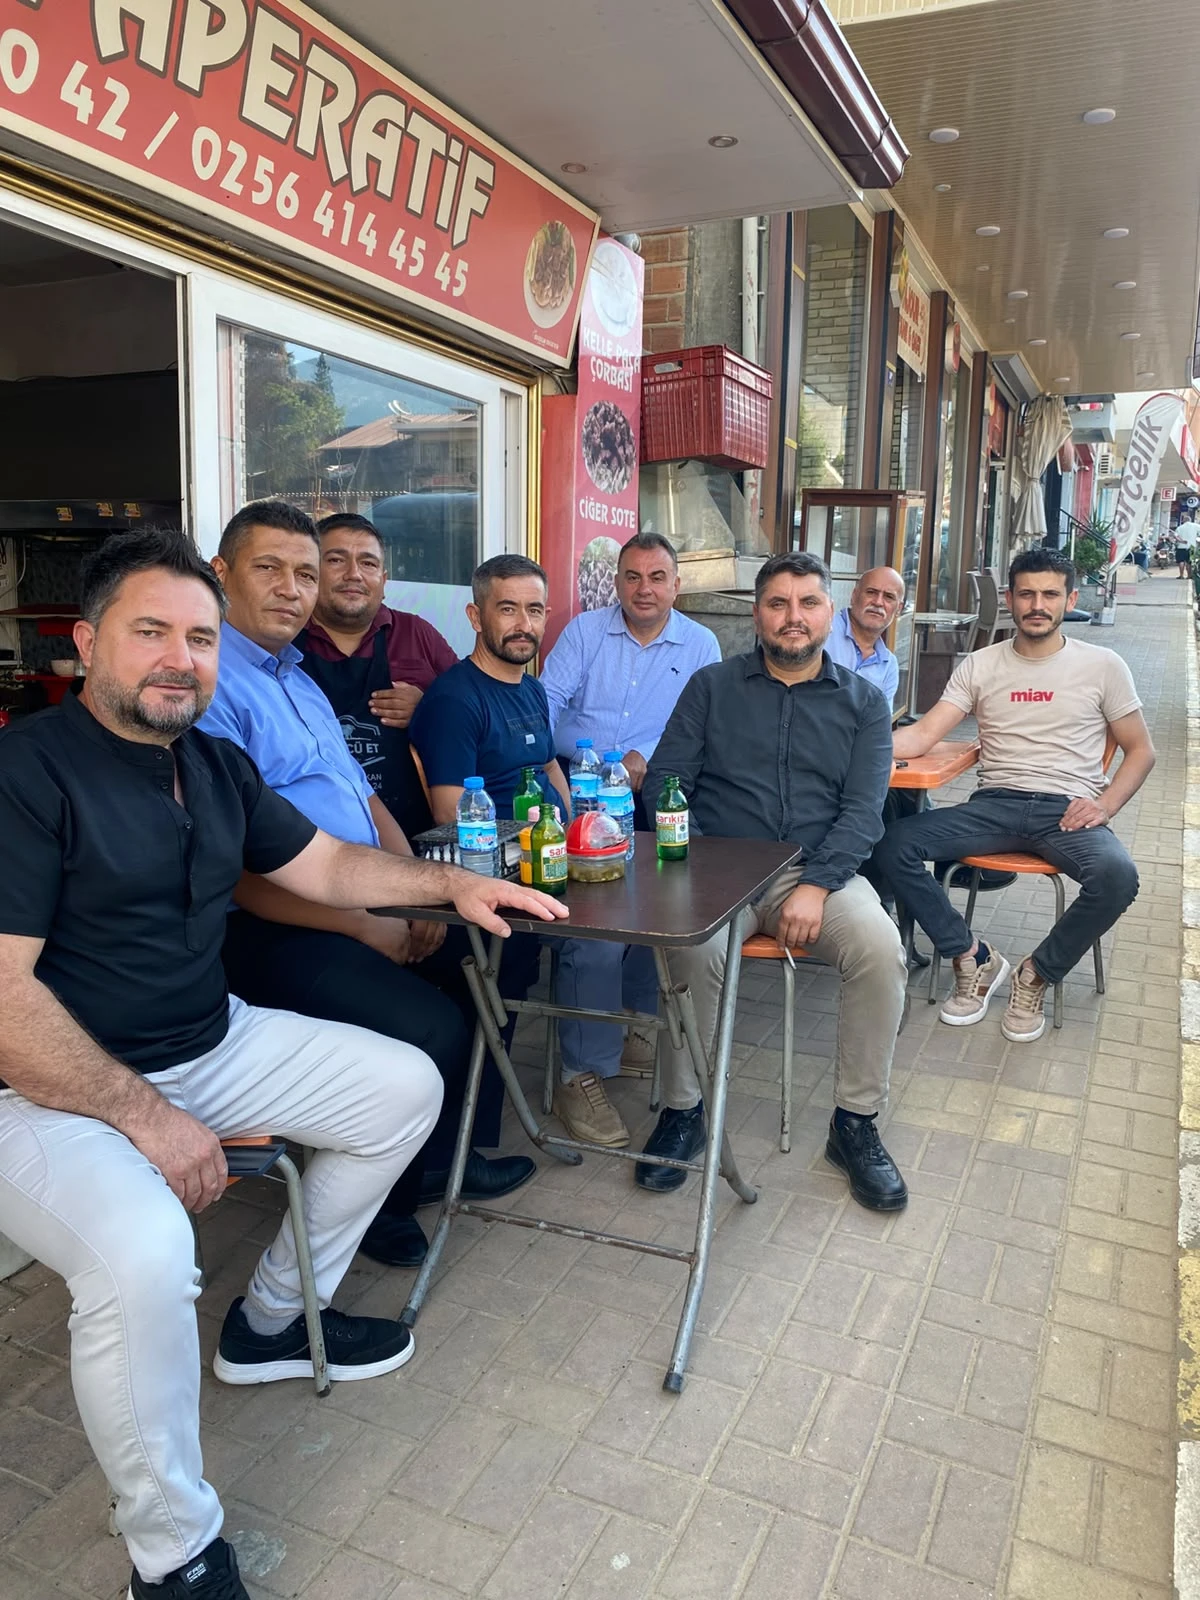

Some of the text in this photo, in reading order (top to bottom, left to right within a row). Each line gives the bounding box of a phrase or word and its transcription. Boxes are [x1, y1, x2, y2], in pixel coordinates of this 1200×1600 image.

[60, 60, 130, 141] 42
[191, 126, 299, 220] 0256
[312, 190, 377, 257] 414
[388, 227, 426, 277] 45
[434, 252, 469, 297] 45
[583, 326, 613, 360] KELLE
[579, 495, 636, 529] CİĞER SOTE
[1010, 688, 1054, 702] miav
[366, 743, 380, 754] ET
